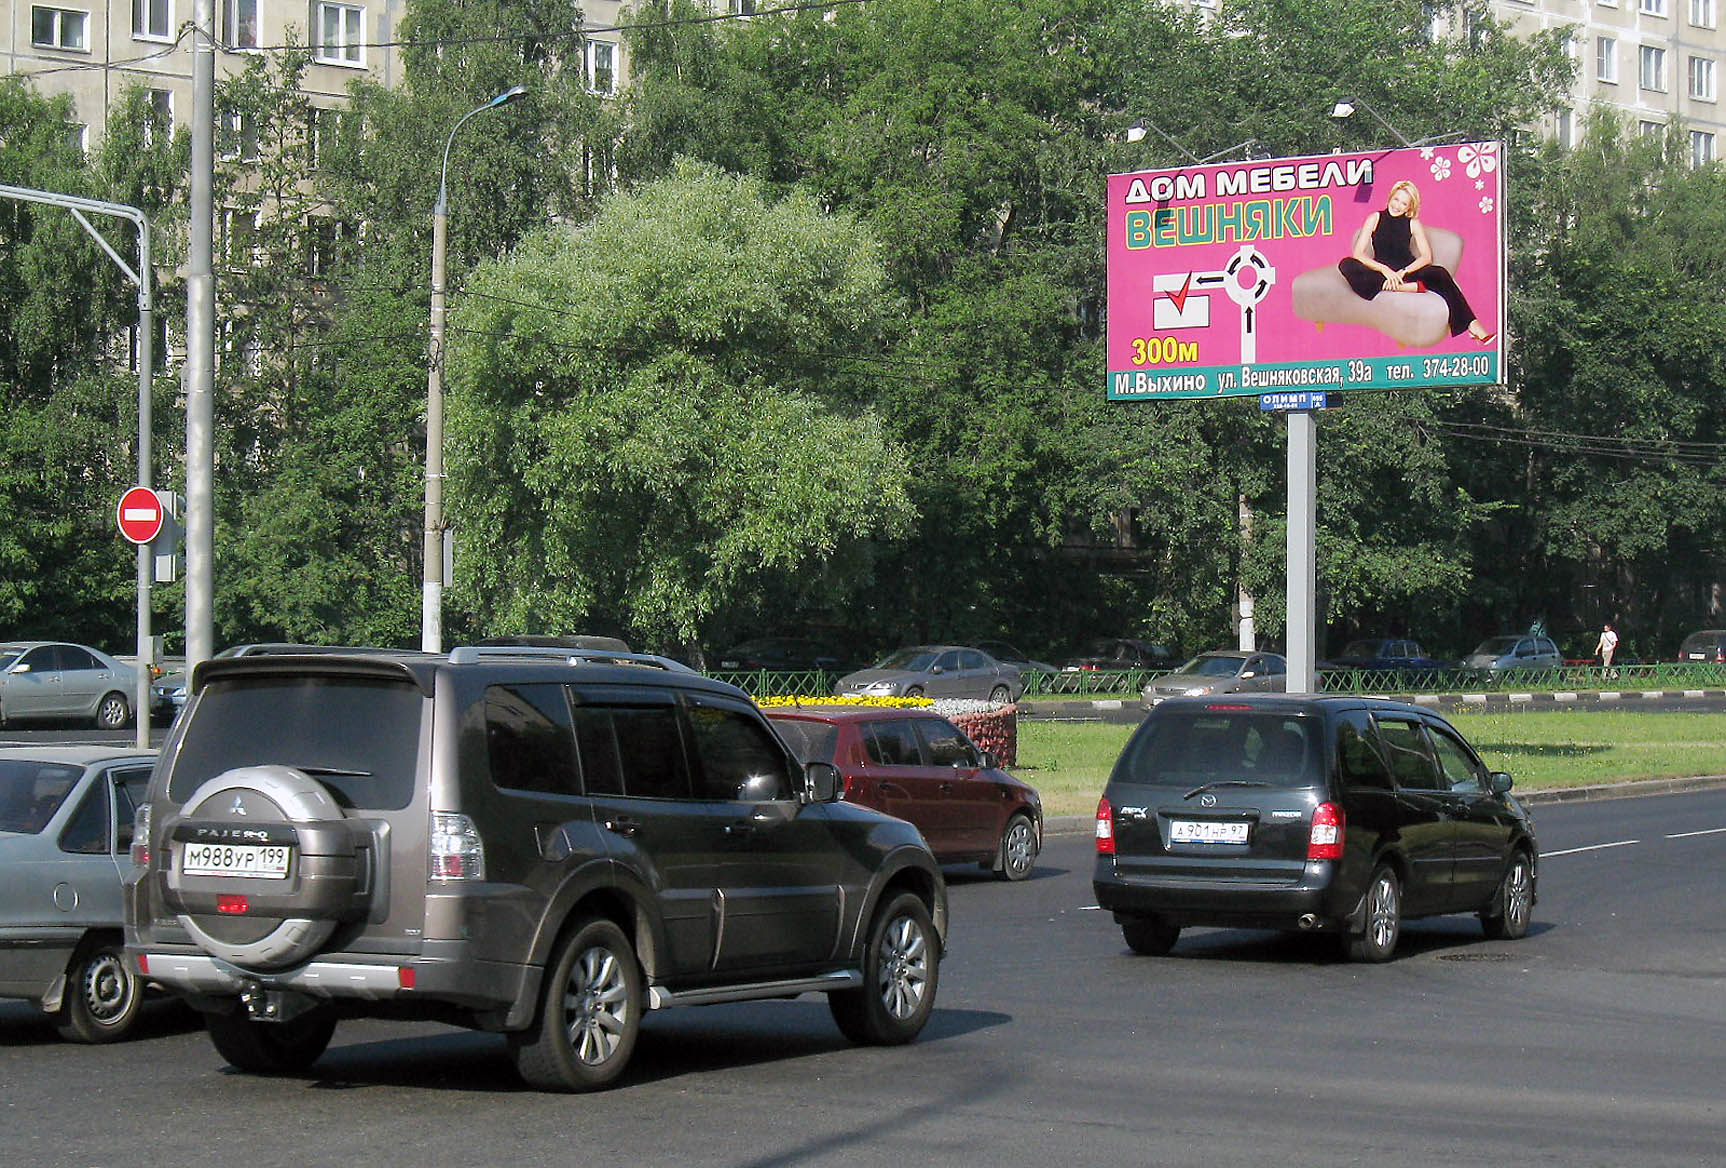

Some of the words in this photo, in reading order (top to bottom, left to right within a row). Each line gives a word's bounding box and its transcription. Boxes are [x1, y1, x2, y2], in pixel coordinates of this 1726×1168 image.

[1125, 173, 1206, 204] ДОМ
[1216, 158, 1374, 197] МЕБЕЛИ
[1125, 194, 1333, 250] ВЕШНЯКИ
[1131, 336, 1199, 365] 300м
[1115, 372, 1206, 394] М.Выхино
[1217, 371, 1237, 394] ул.
[1241, 366, 1344, 388] Вешняковская,
[1348, 360, 1373, 383] 39а
[1386, 364, 1414, 380] тел.
[1423, 356, 1489, 379] 374-28-00
[1263, 393, 1306, 404] ОЛИМП
[197, 828, 269, 839] PAJERO
[260, 847, 284, 864] 199
